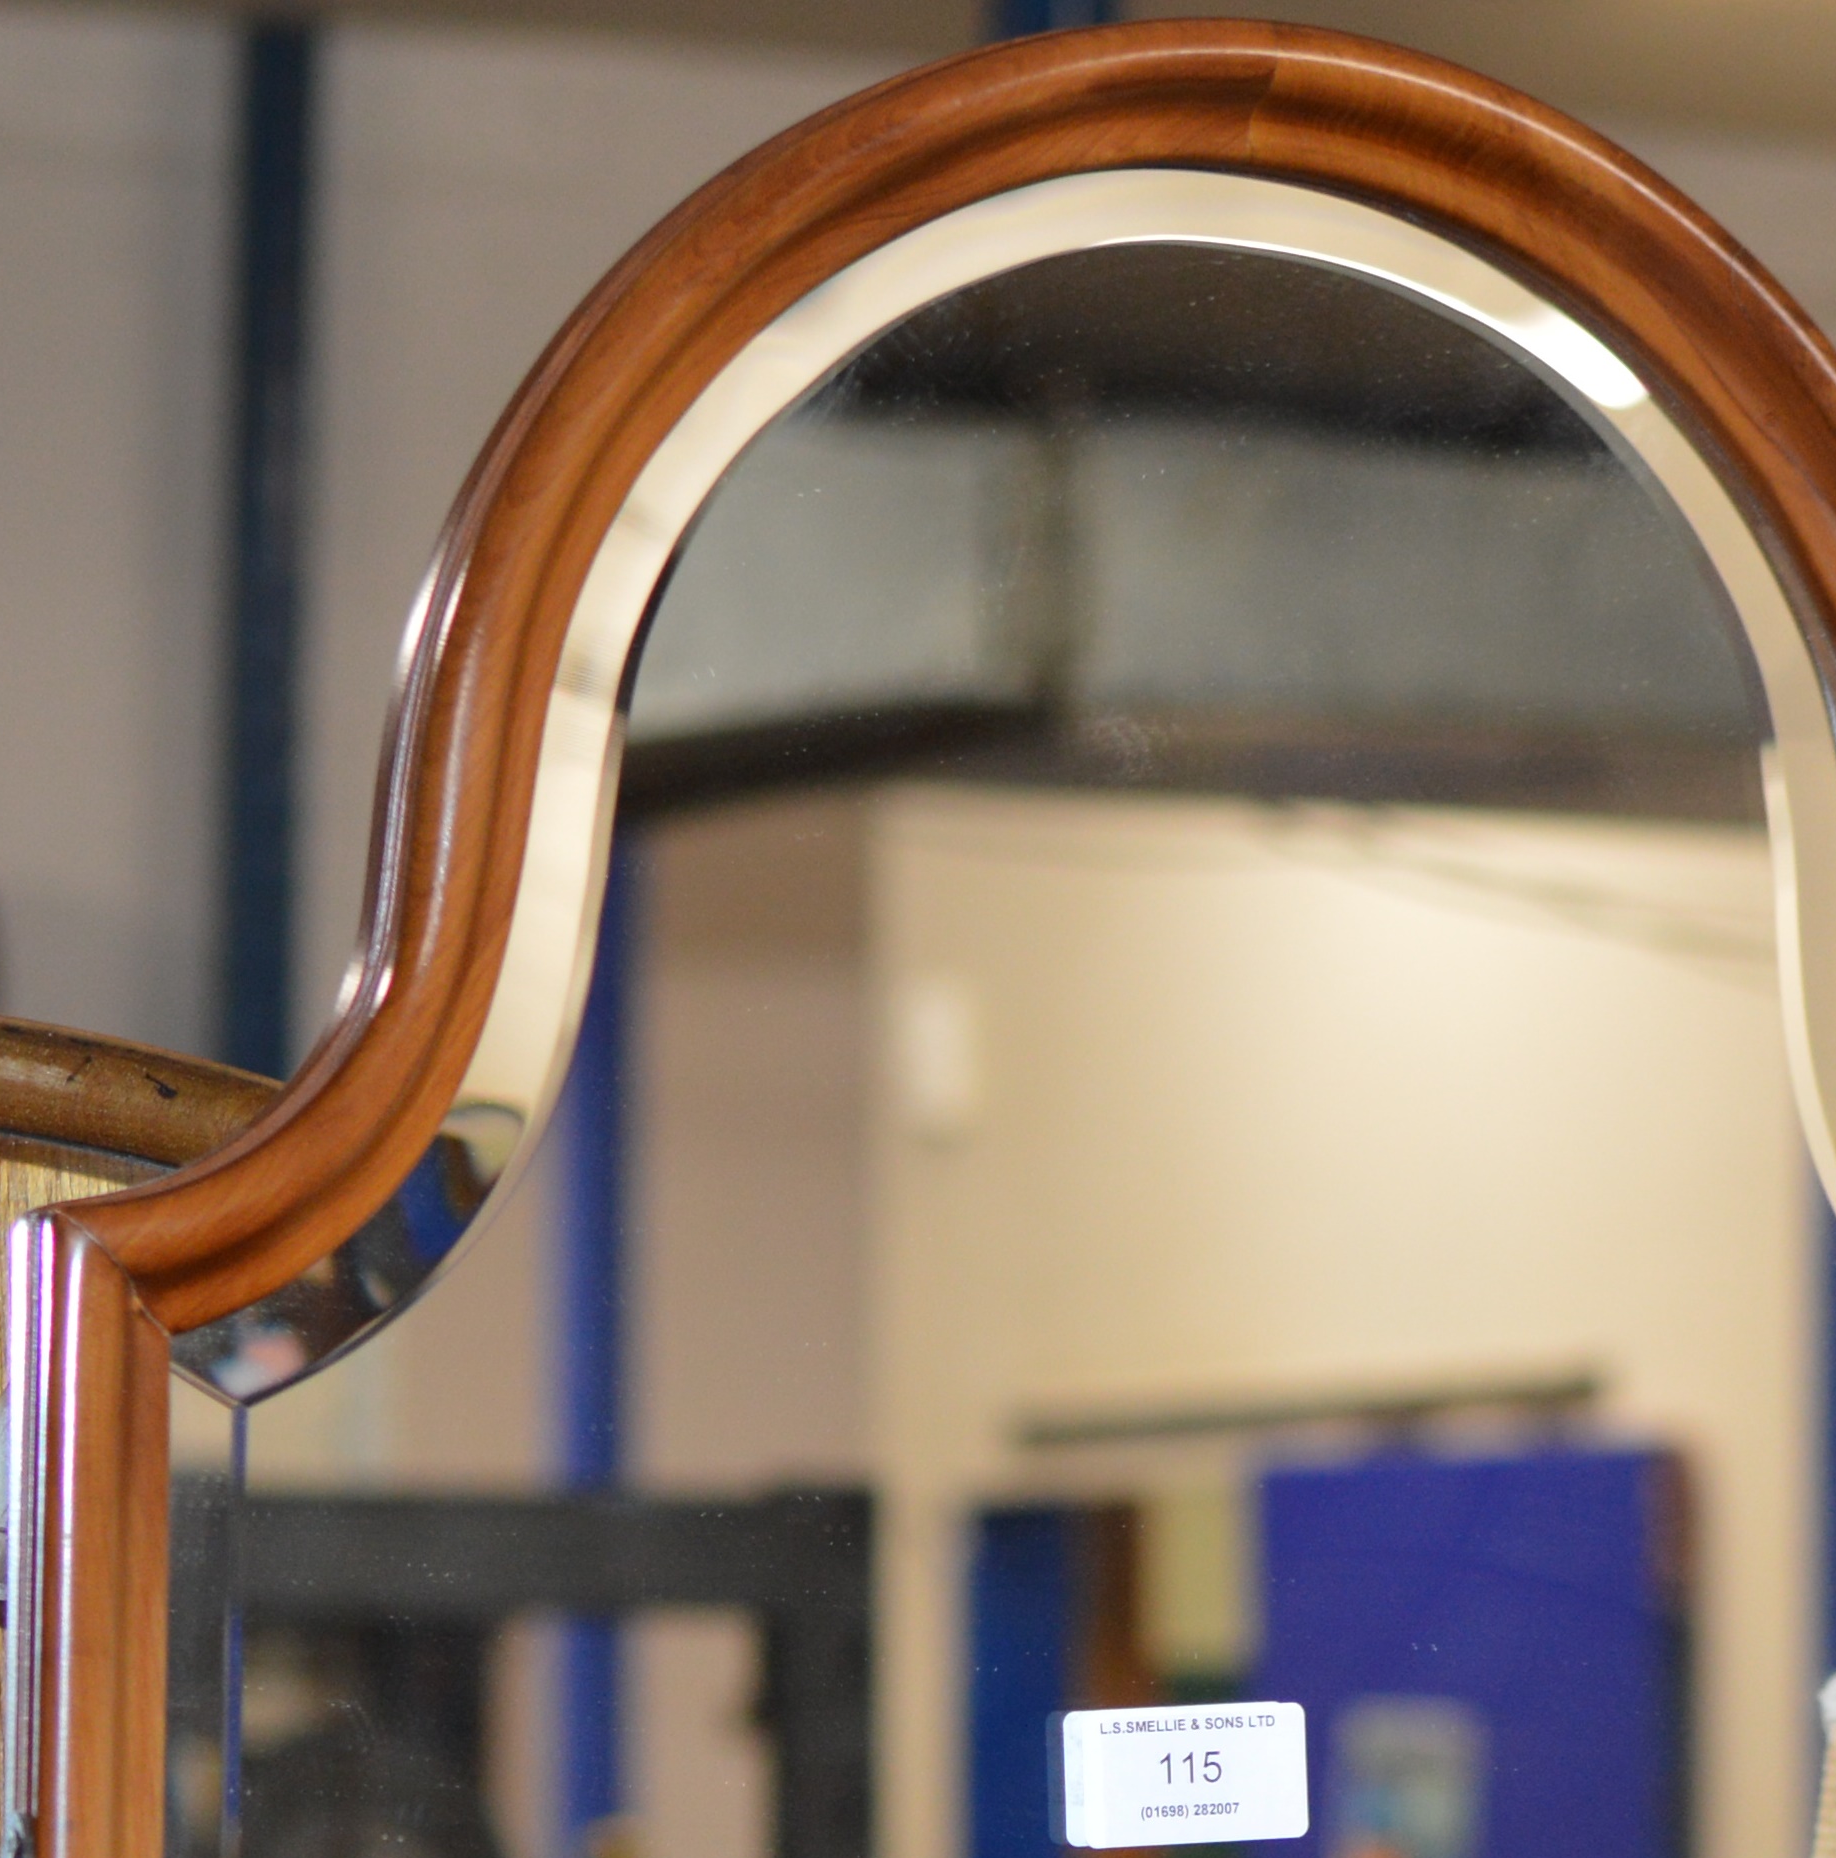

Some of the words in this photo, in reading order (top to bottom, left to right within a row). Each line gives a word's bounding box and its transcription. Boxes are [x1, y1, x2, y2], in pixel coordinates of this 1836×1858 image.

[1099, 1717, 1187, 1735] L.S.SMELLIE
[1190, 1717, 1200, 1730] &
[1204, 1715, 1244, 1730] SONS
[1248, 1714, 1276, 1728] LTD
[1159, 1750, 1223, 1785] 115
[1140, 1804, 1189, 1821] (01698)
[1193, 1802, 1240, 1817] 282007
